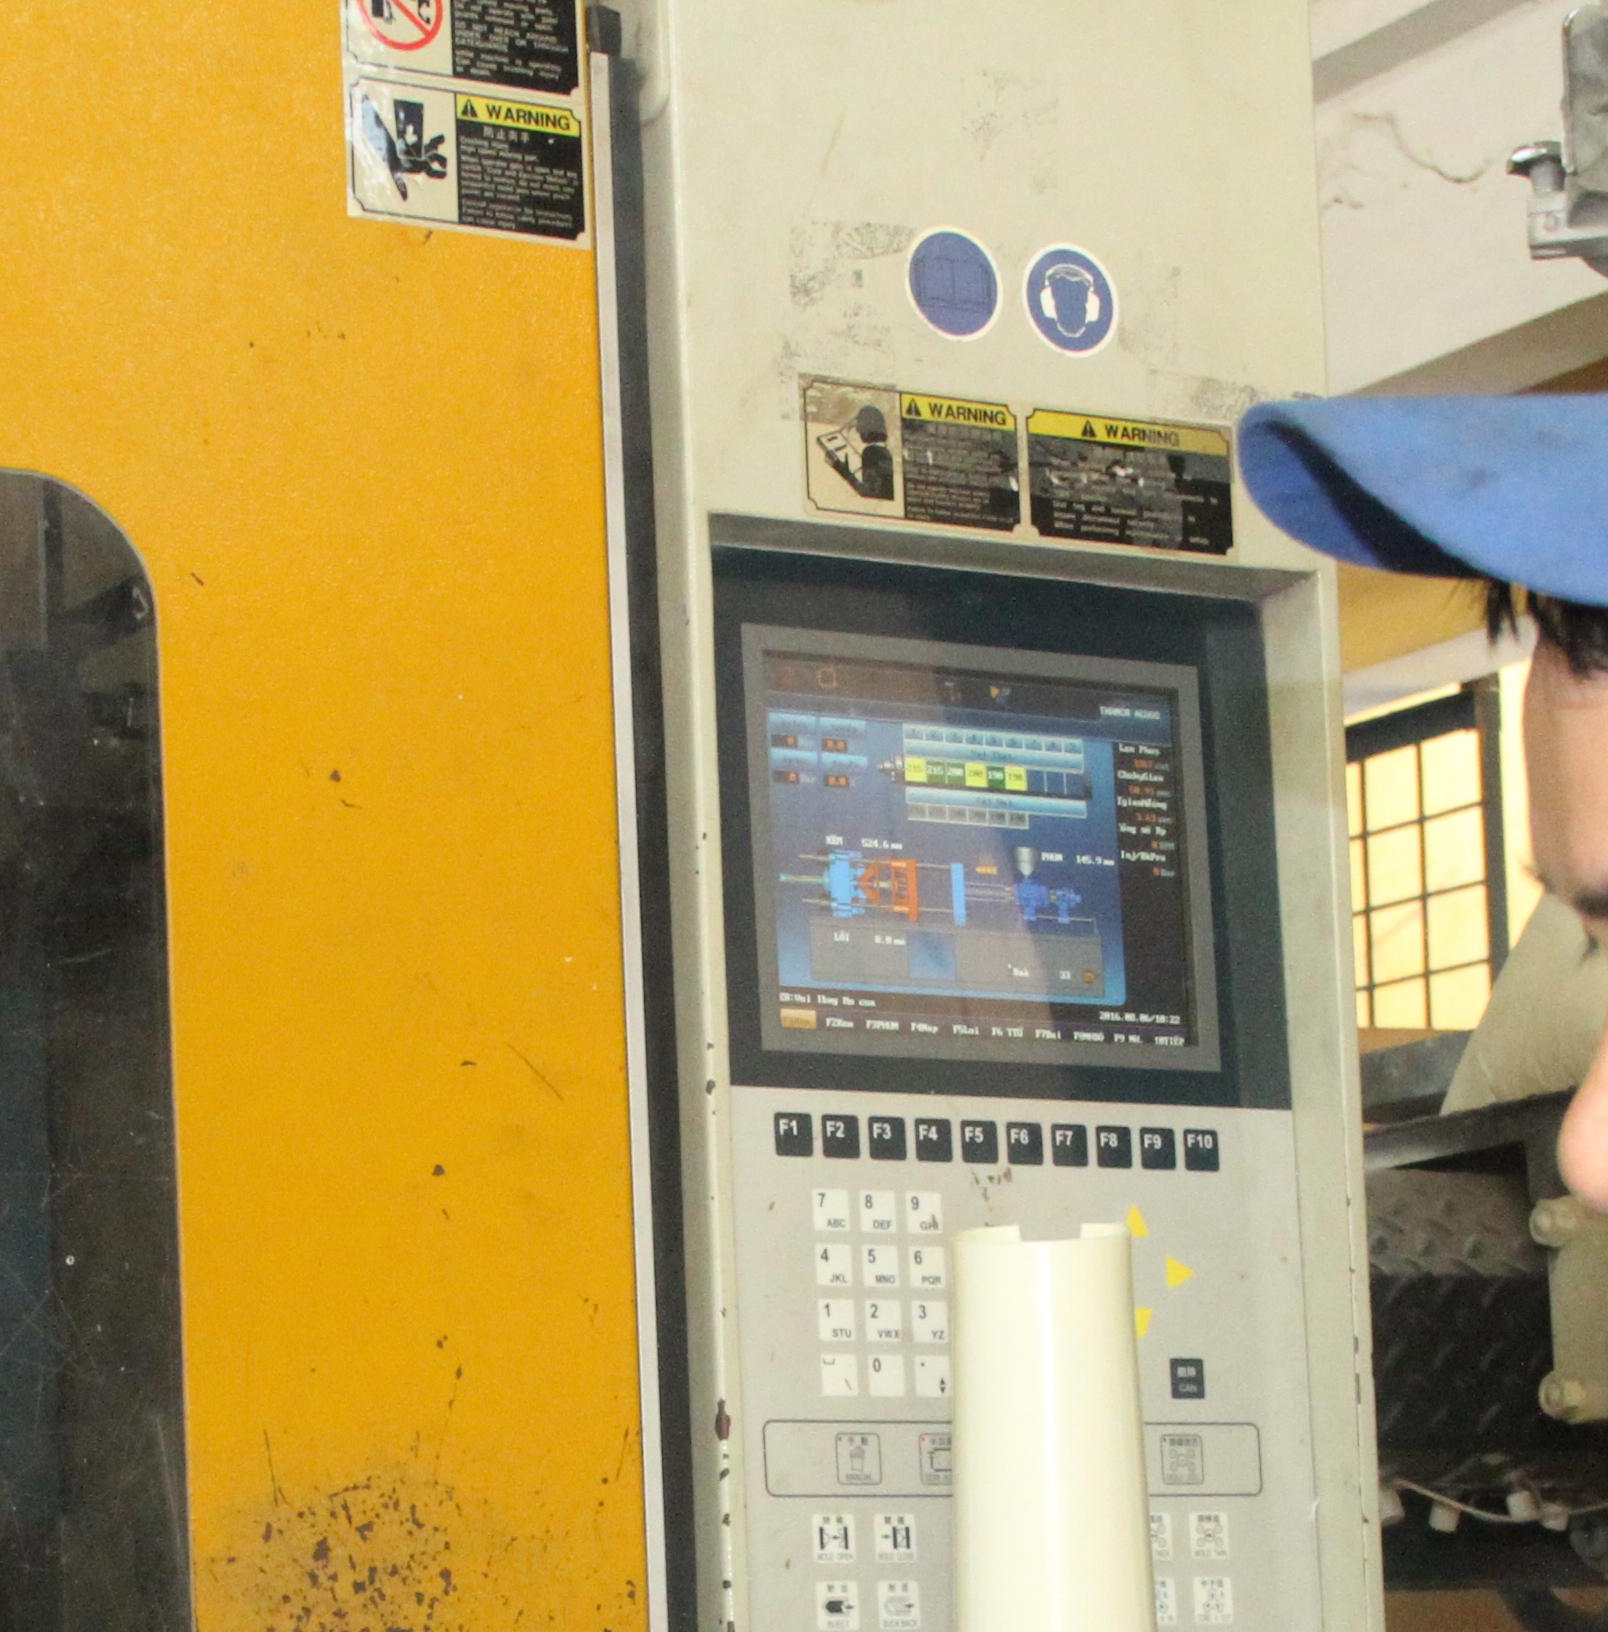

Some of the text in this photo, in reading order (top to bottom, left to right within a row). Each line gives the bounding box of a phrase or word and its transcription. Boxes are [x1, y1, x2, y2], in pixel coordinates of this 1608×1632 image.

[486, 103, 570, 131] WARNING
[929, 402, 1006, 425] WARNING
[1105, 423, 1179, 447] WARNING
[778, 1118, 798, 1136] F1
[825, 1120, 845, 1138] F2
[872, 1122, 892, 1140] F3
[918, 1124, 938, 1141] F4
[964, 1126, 984, 1143] F5
[1010, 1128, 1030, 1145] F6
[1055, 1130, 1074, 1146] F7
[1099, 1132, 1118, 1148] F8
[1143, 1134, 1163, 1149] F9
[1186, 1134, 1213, 1149] F10
[817, 1192, 826, 1207] 7
[864, 1194, 873, 1209] 8
[910, 1195, 920, 1211] 9
[826, 1218, 846, 1229] ABC
[872, 1219, 892, 1230] DEF
[820, 1247, 829, 1263] 4
[867, 1248, 876, 1264] 5
[913, 1250, 923, 1265] 6
[824, 1302, 831, 1318] 1
[869, 1303, 879, 1319] 2
[918, 1304, 927, 1320] 3
[831, 1328, 852, 1339] STU
[931, 1329, 945, 1340] YZ
[872, 1357, 882, 1373] 0
